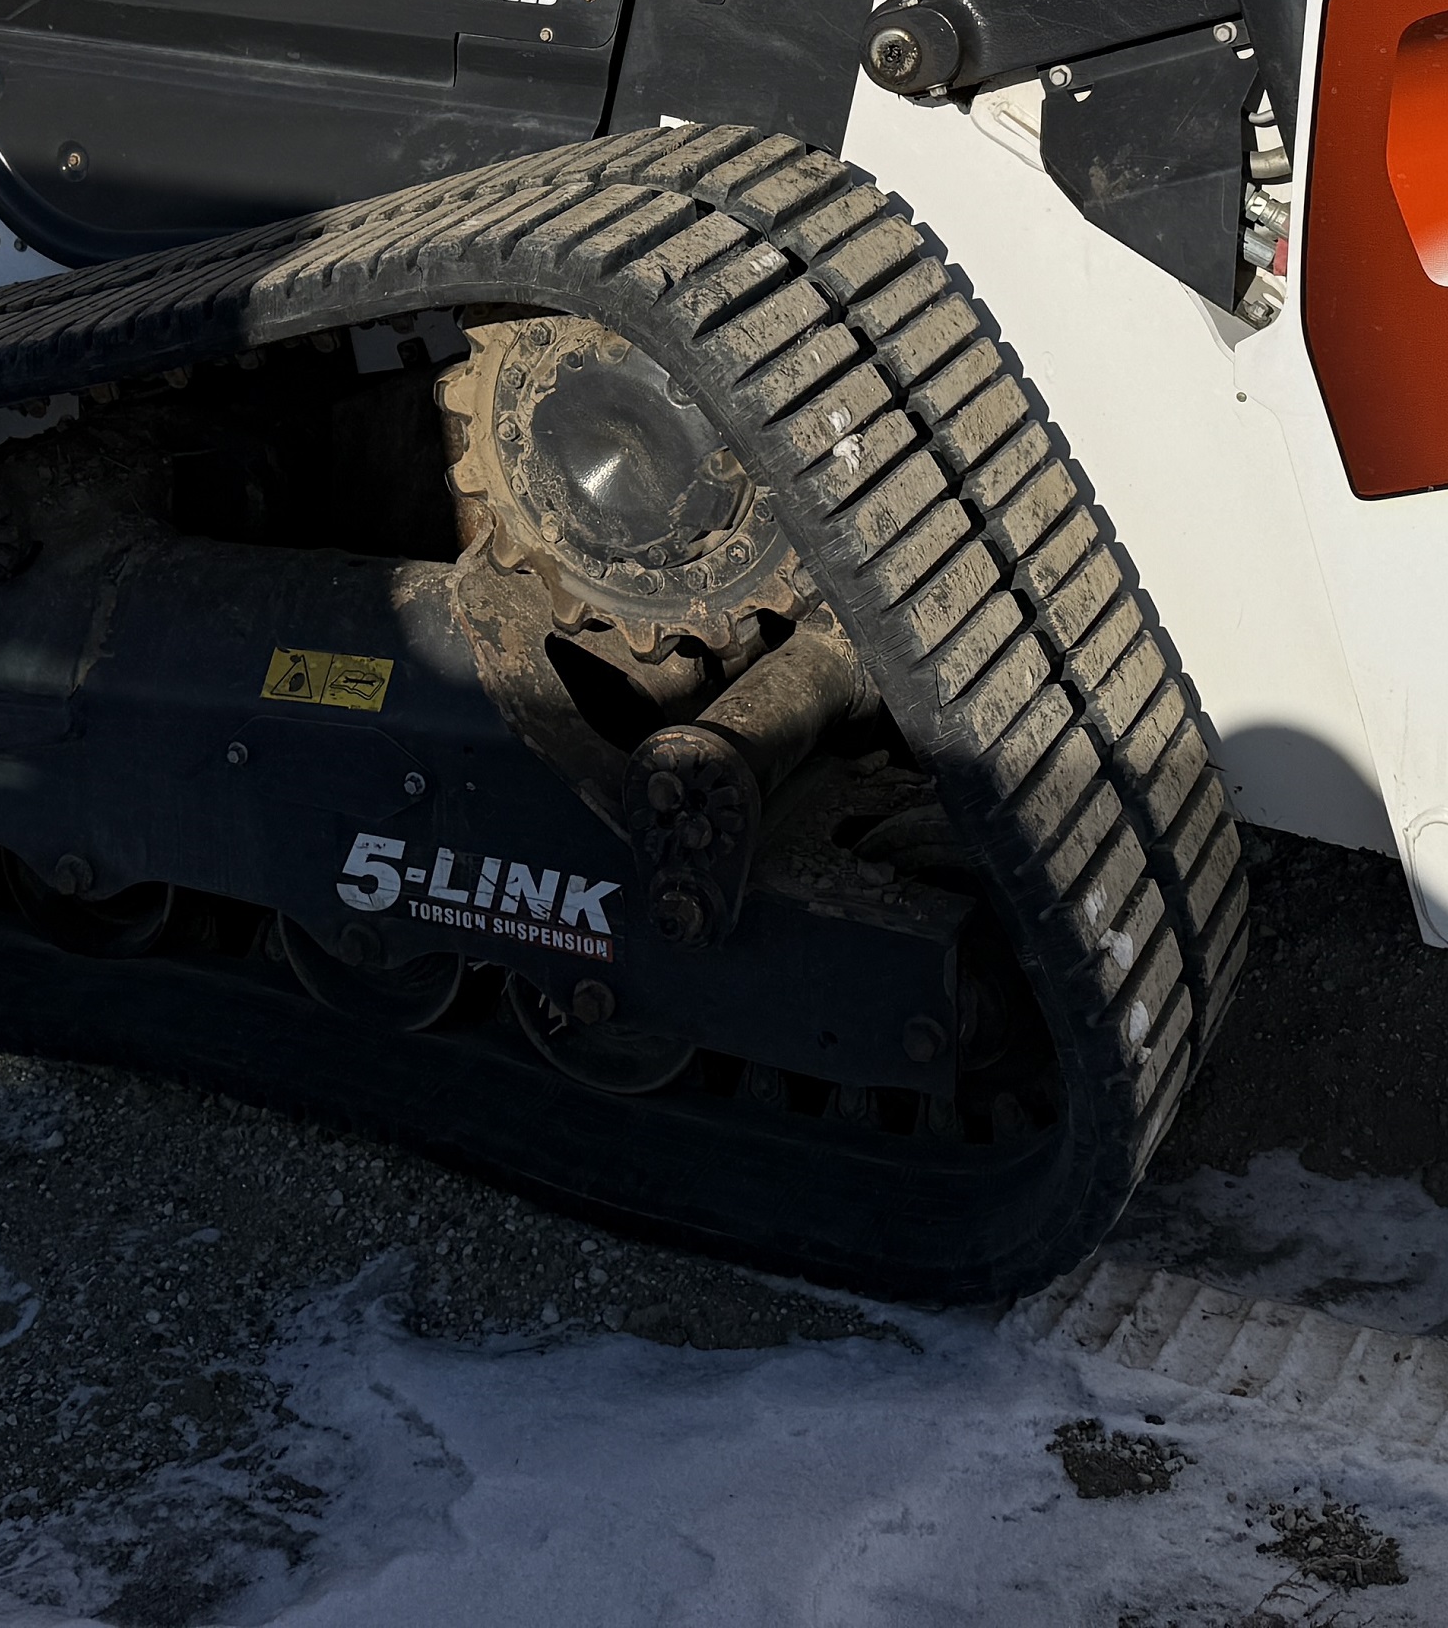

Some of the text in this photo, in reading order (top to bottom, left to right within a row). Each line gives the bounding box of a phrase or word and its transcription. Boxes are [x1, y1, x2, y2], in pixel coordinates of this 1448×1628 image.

[336, 832, 622, 935] 5-LINK
[408, 900, 609, 958] TORSION SUSPENSION
